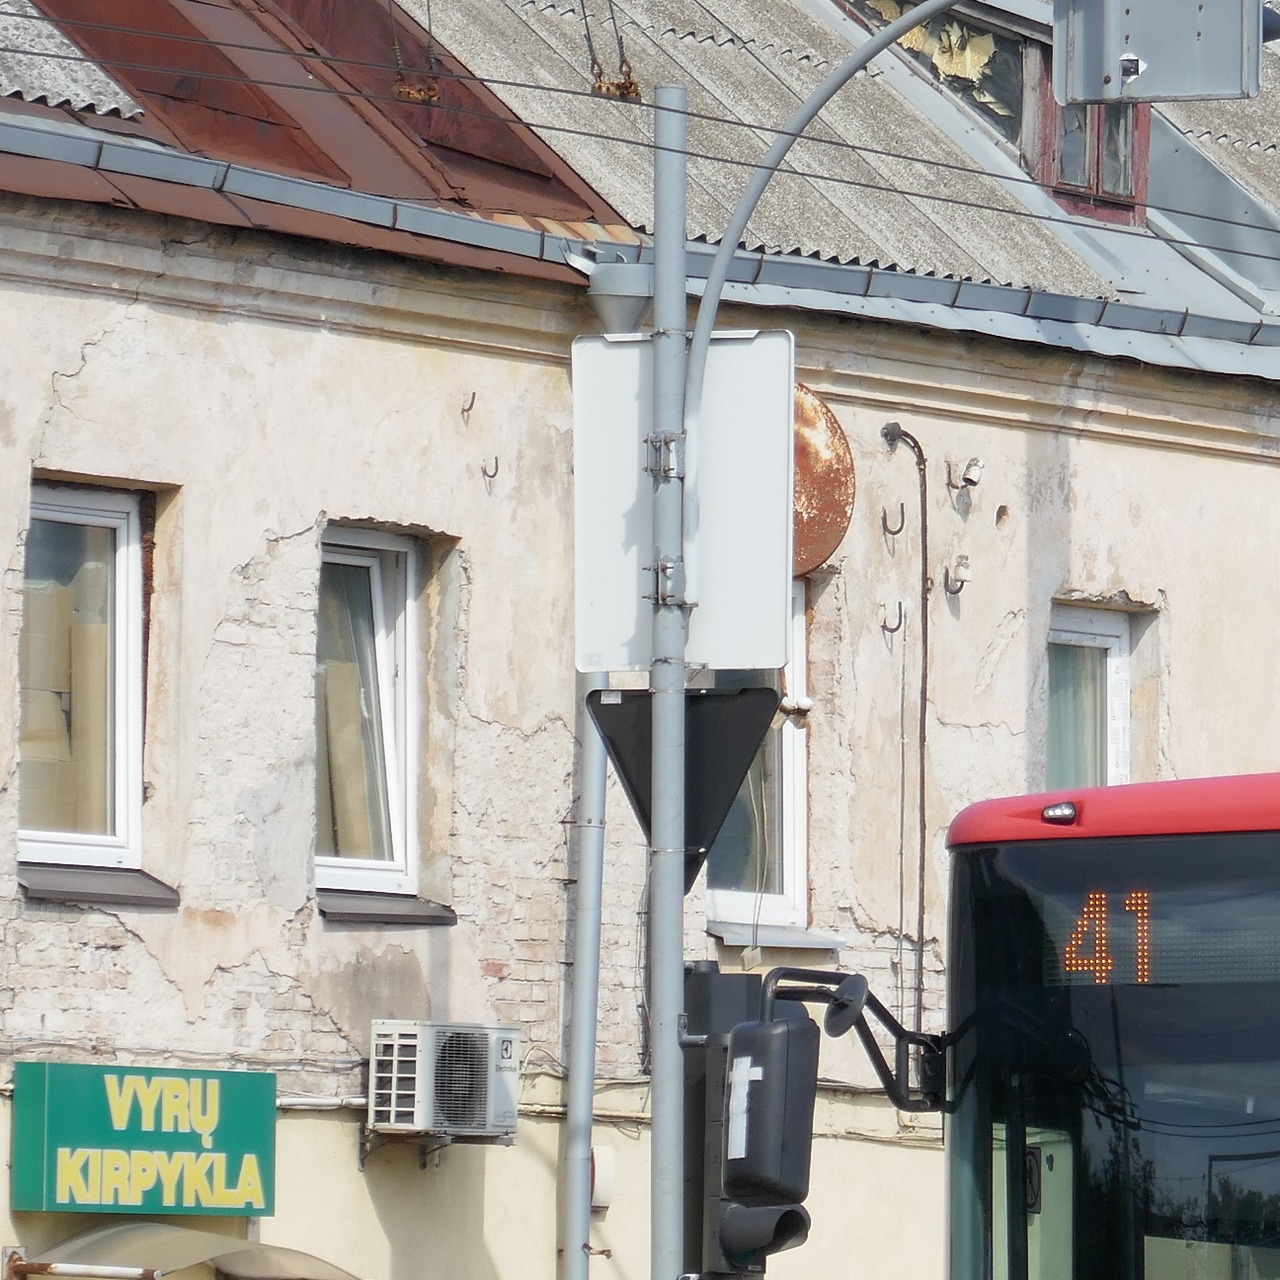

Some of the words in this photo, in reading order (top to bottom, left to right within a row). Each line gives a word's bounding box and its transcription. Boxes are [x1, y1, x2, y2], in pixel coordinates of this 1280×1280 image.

[1064, 889, 1150, 985] 41
[104, 1074, 220, 1149] VYRŲ
[56, 1147, 266, 1209] KIRPYKLA
